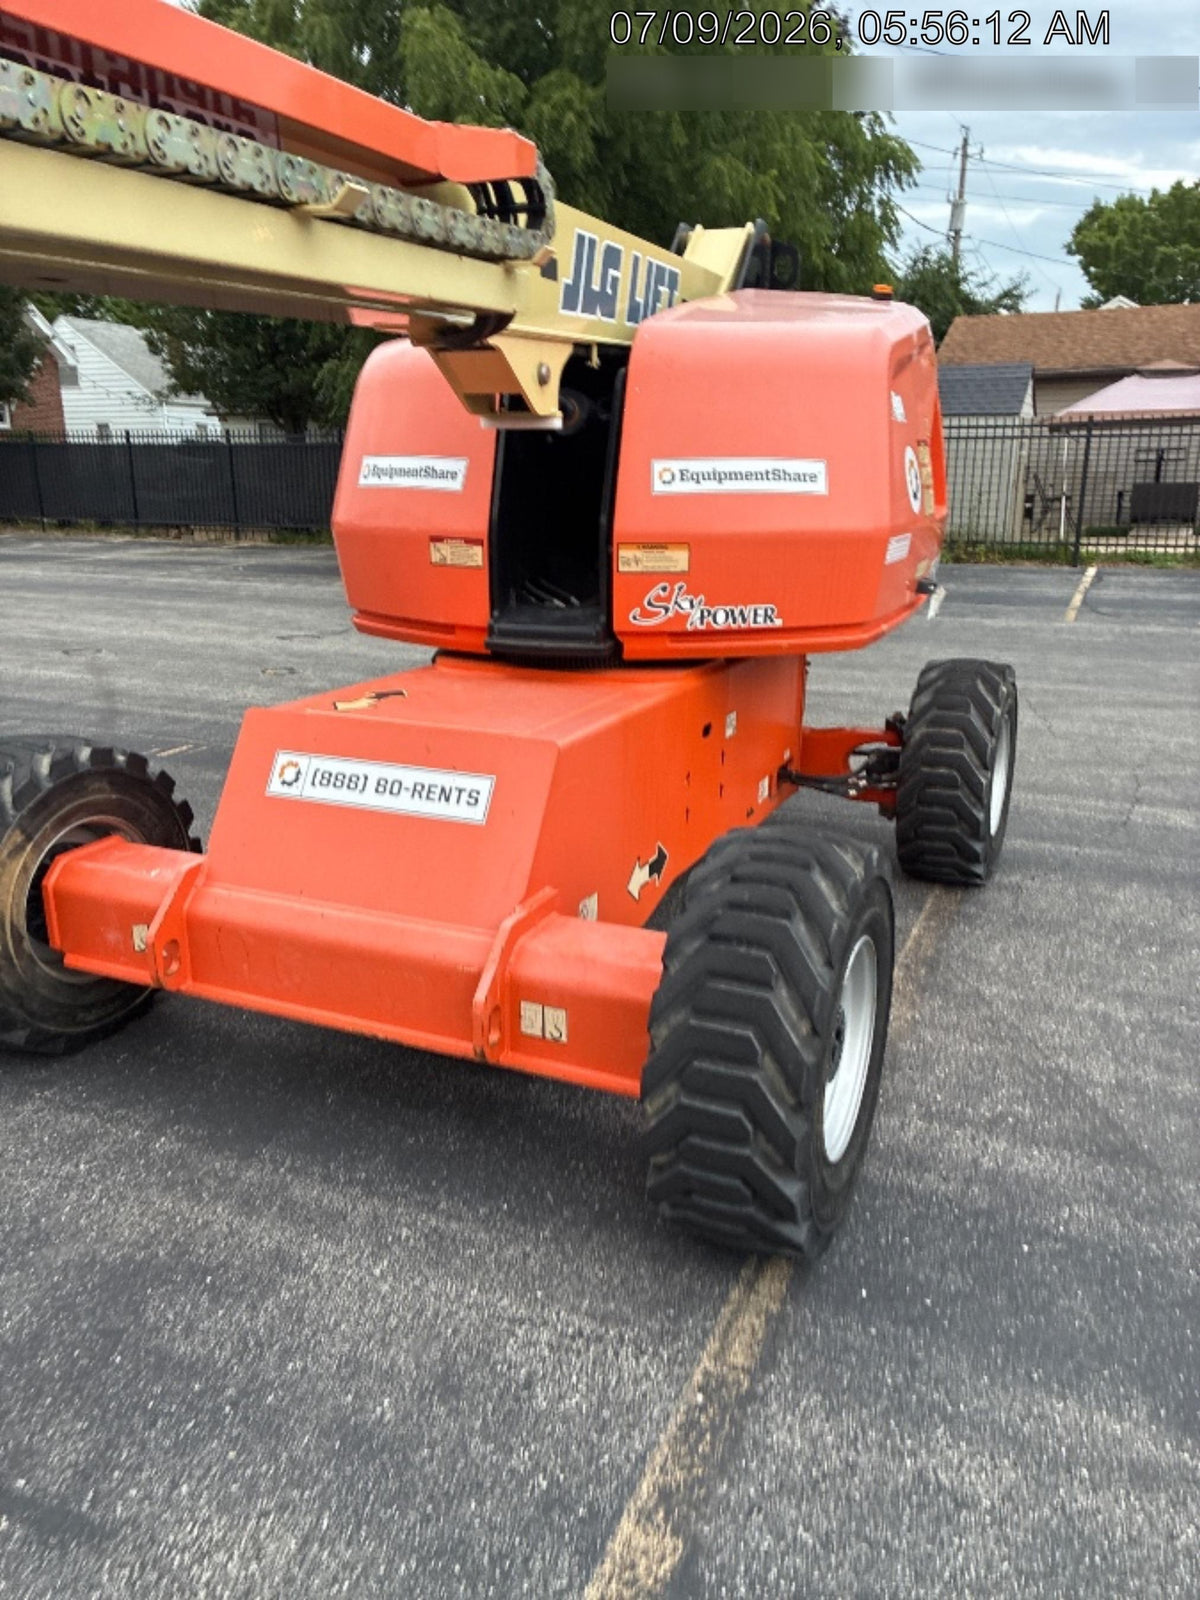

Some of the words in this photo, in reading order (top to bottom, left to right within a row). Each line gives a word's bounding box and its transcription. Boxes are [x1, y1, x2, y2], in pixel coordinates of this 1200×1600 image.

[560, 228, 624, 323] JLG
[625, 251, 682, 325] LIFT
[371, 464, 458, 481] EquipmentShare
[678, 467, 819, 485] EquipmentShare
[310, 767, 369, 794] (888)
[373, 777, 482, 808] 80-RENTS
